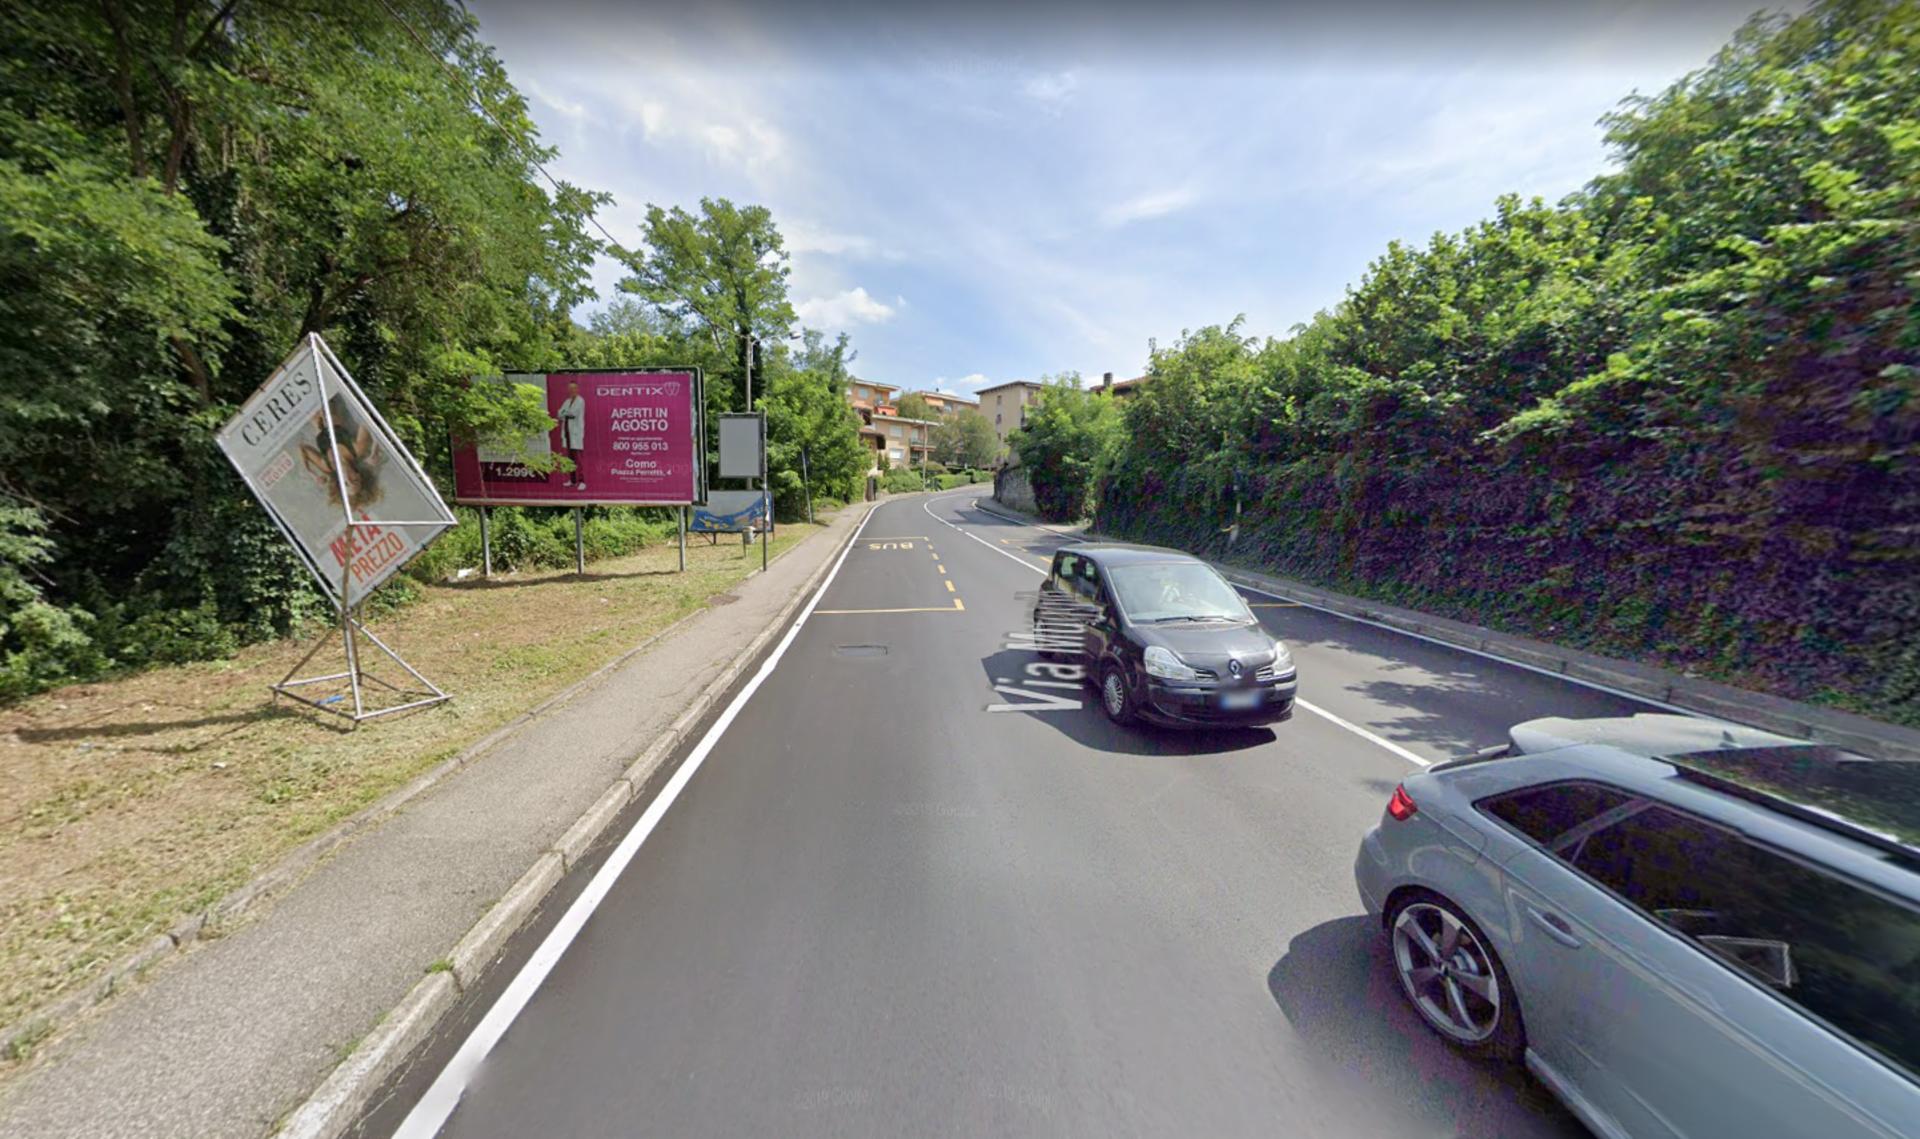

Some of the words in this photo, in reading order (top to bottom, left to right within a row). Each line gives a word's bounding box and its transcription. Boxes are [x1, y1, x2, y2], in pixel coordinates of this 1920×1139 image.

[596, 386, 664, 397] DENTIX
[241, 372, 314, 447] CERES
[611, 407, 653, 419] APERTI
[655, 407, 668, 418] IN
[611, 419, 669, 432] AGOSTO
[651, 442, 669, 452] 013
[625, 458, 657, 469] Como
[868, 541, 914, 551] BUS
[350, 531, 405, 583] PREZZO
